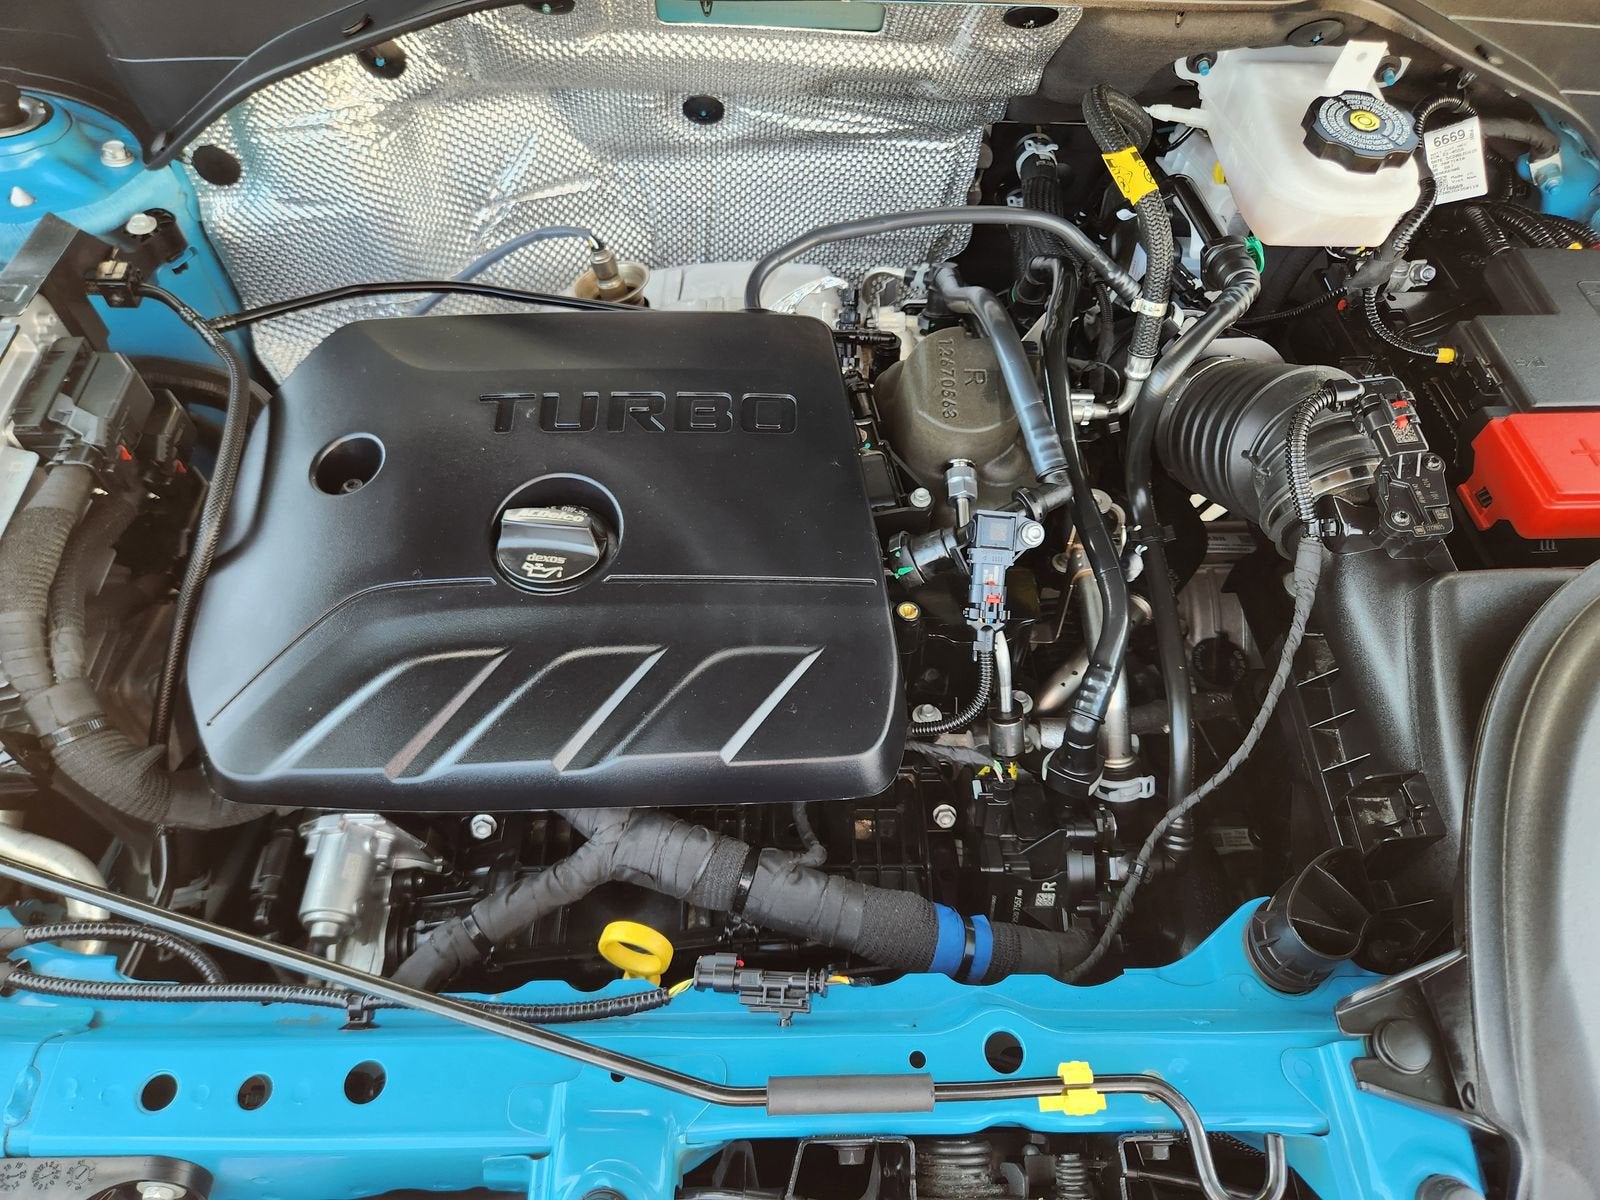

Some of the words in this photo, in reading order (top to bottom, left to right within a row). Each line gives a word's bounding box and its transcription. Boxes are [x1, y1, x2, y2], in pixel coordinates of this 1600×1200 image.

[1433, 129, 1466, 148] 6669
[964, 368, 987, 386] R
[479, 391, 798, 434] TURBO
[526, 553, 567, 564] dexos
[1042, 881, 1057, 892] R
